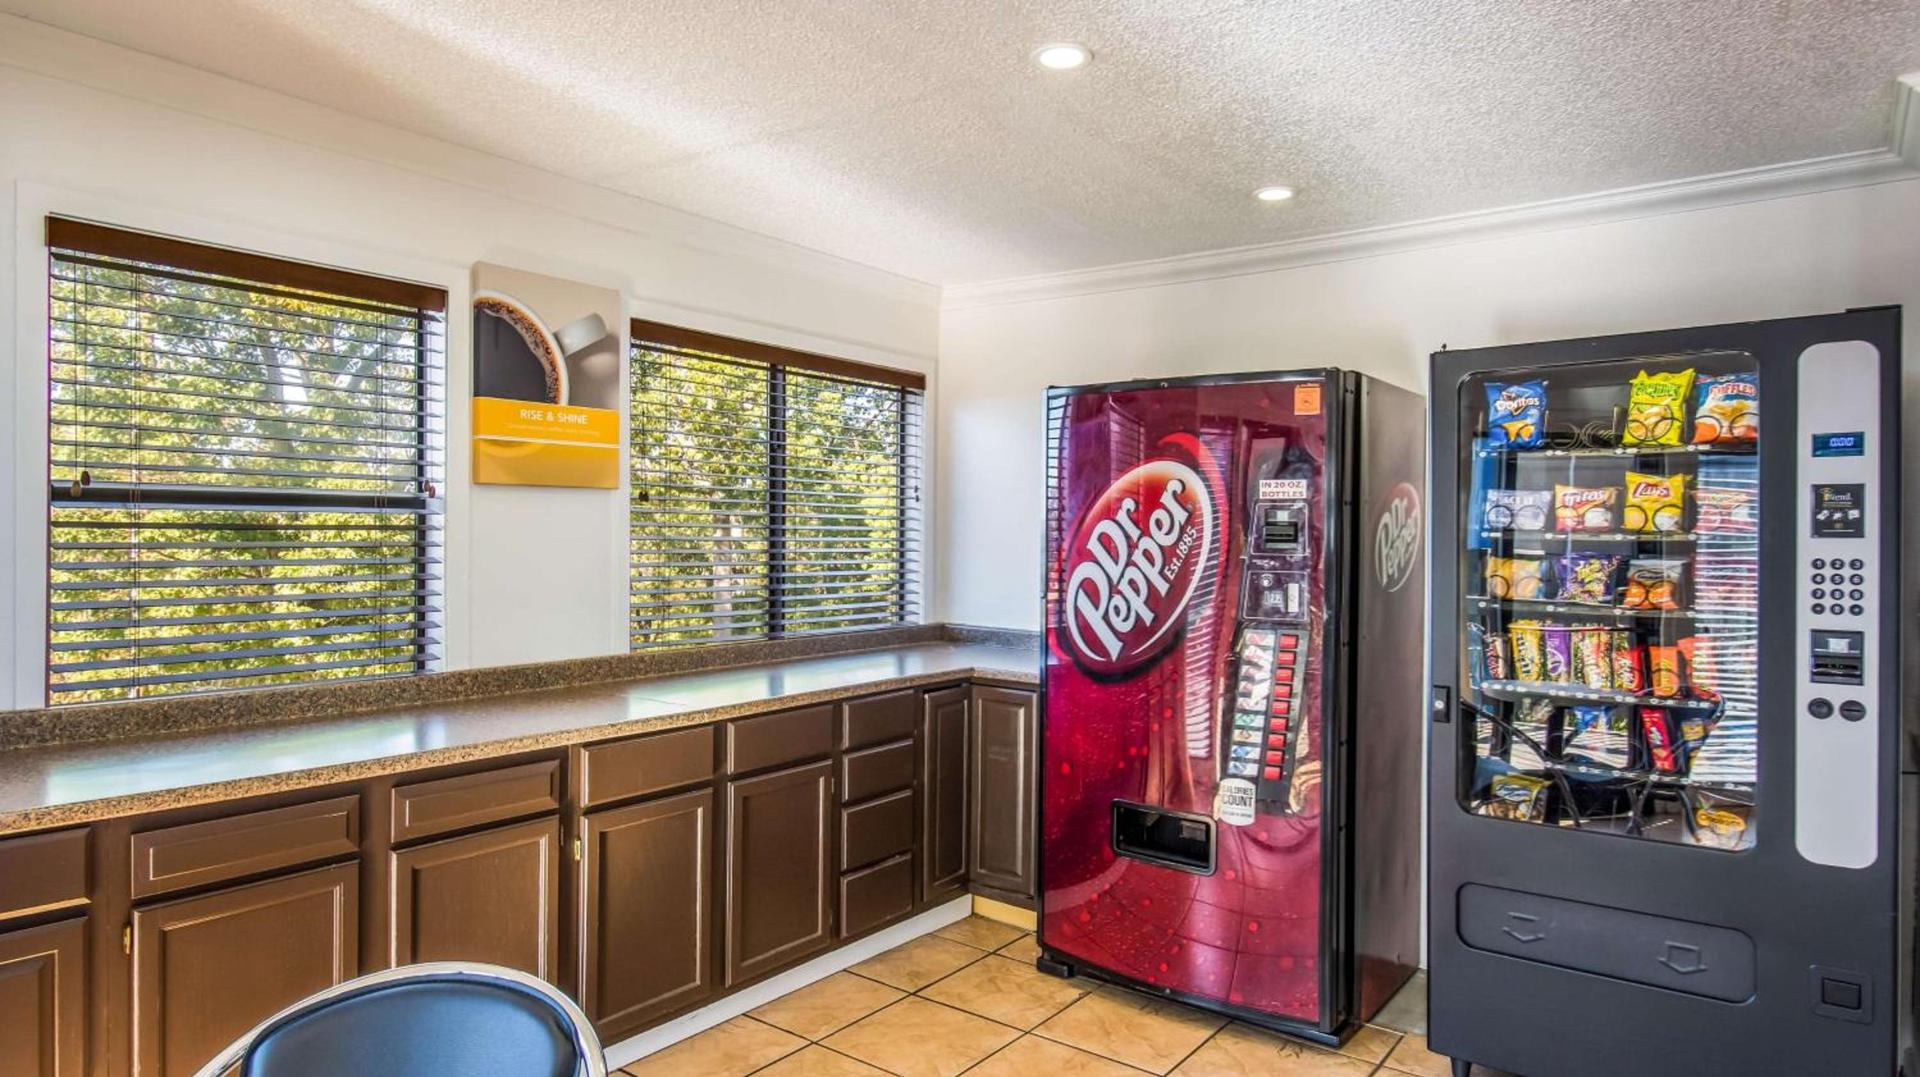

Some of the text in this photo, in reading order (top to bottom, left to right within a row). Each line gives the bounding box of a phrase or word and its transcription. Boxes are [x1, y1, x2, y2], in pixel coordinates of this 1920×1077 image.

[520, 409, 588, 425] RISE & SHINE
[1495, 397, 1540, 411] Doritos
[1391, 497, 1408, 537] Dr
[1086, 497, 1142, 584] Dr
[1376, 511, 1417, 586] Pepper
[1067, 479, 1189, 662] Pepper
[1222, 793, 1254, 807] COUNT
